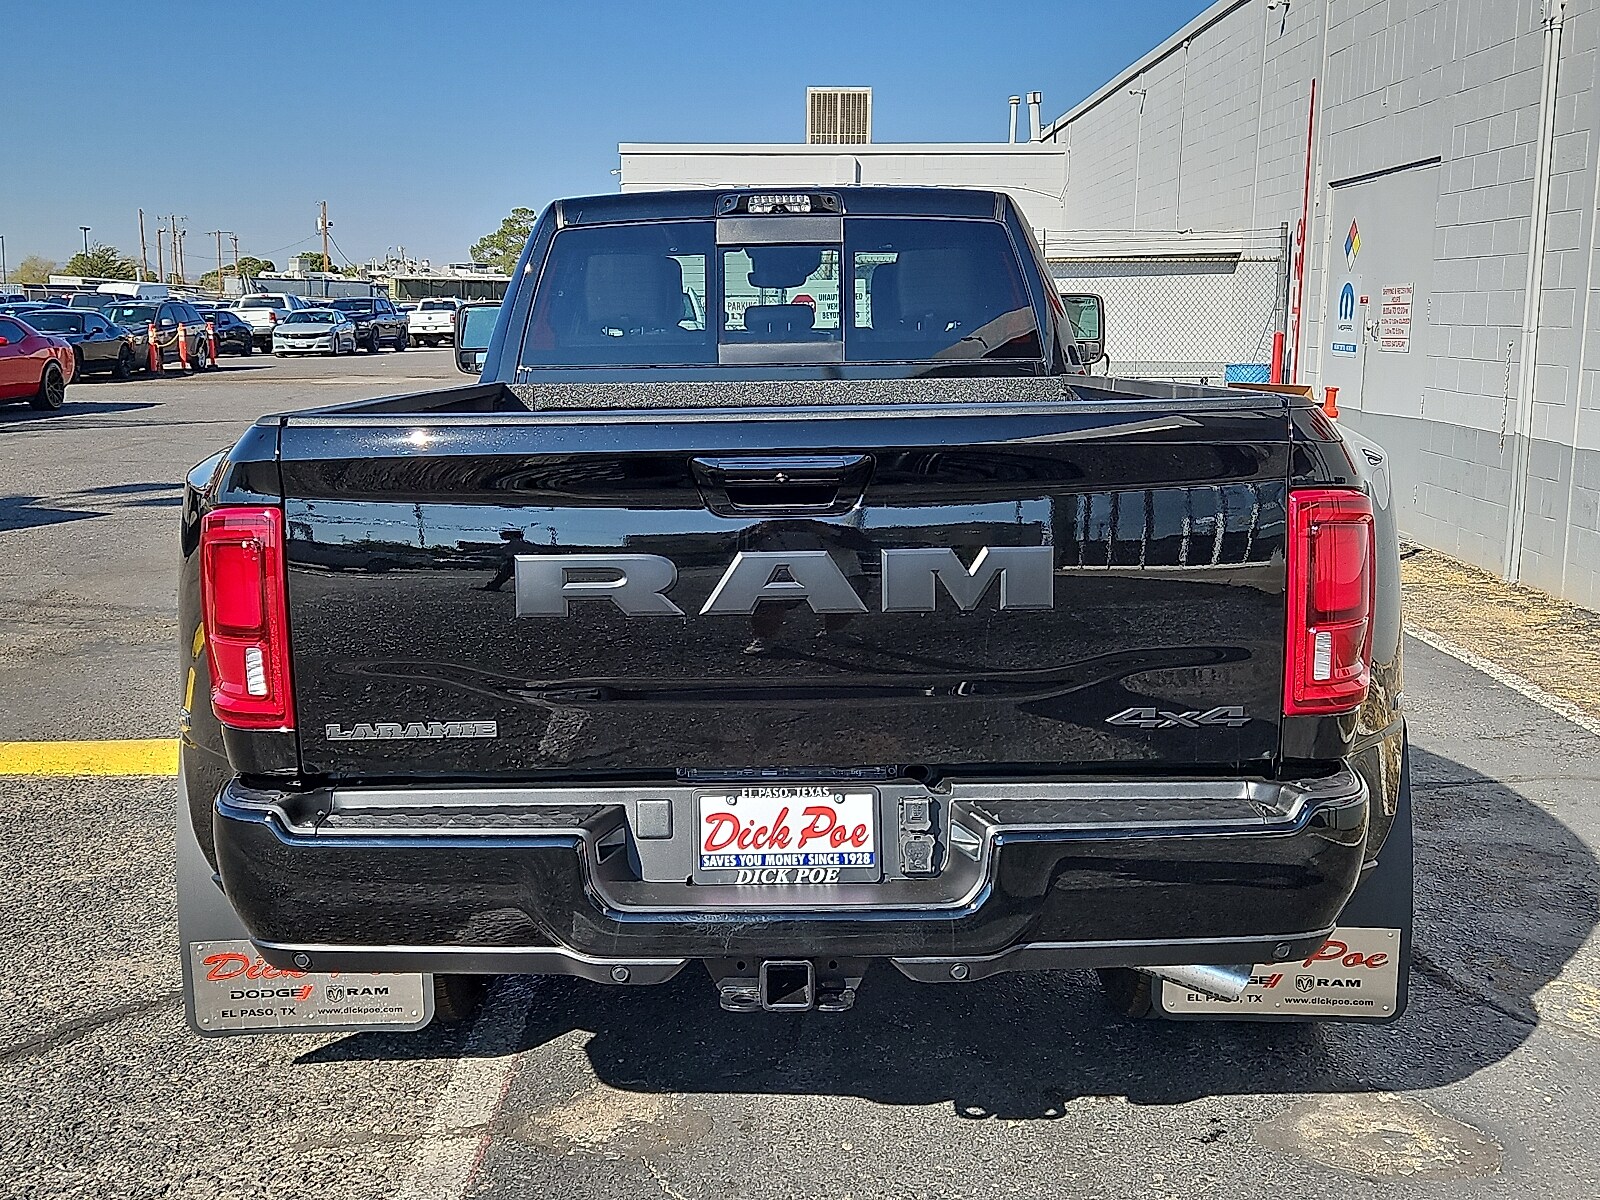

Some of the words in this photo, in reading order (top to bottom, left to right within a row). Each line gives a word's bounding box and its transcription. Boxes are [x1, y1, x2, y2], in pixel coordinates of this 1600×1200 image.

[514, 545, 1055, 618] RAM
[1104, 705, 1252, 729] 4x4
[325, 720, 498, 741] LARAMIE
[741, 788, 754, 798] EL
[758, 787, 792, 798] PASO,
[795, 786, 830, 797] TEXAS
[704, 806, 793, 852] Dick
[798, 805, 869, 849] Poe
[702, 855, 737, 867] SAVES
[739, 854, 762, 866] YOU
[764, 854, 806, 866] MONEY
[808, 853, 840, 865] SINCE
[843, 852, 871, 865] 1928
[734, 868, 789, 884] DICK
[794, 867, 840, 883] POE
[1302, 940, 1389, 968] Poe
[1317, 979, 1361, 988] RAM
[230, 988, 304, 1000] DODGE
[346, 986, 389, 996] RAM
[1187, 993, 1202, 1002] EL
[1247, 994, 1263, 1003] TX
[1284, 997, 1375, 1007] www.dickpoe.com
[221, 1009, 237, 1018] EL
[240, 1008, 277, 1018] PASO,
[280, 1007, 297, 1016] TX
[317, 1005, 403, 1015] www.dickpoe.com
